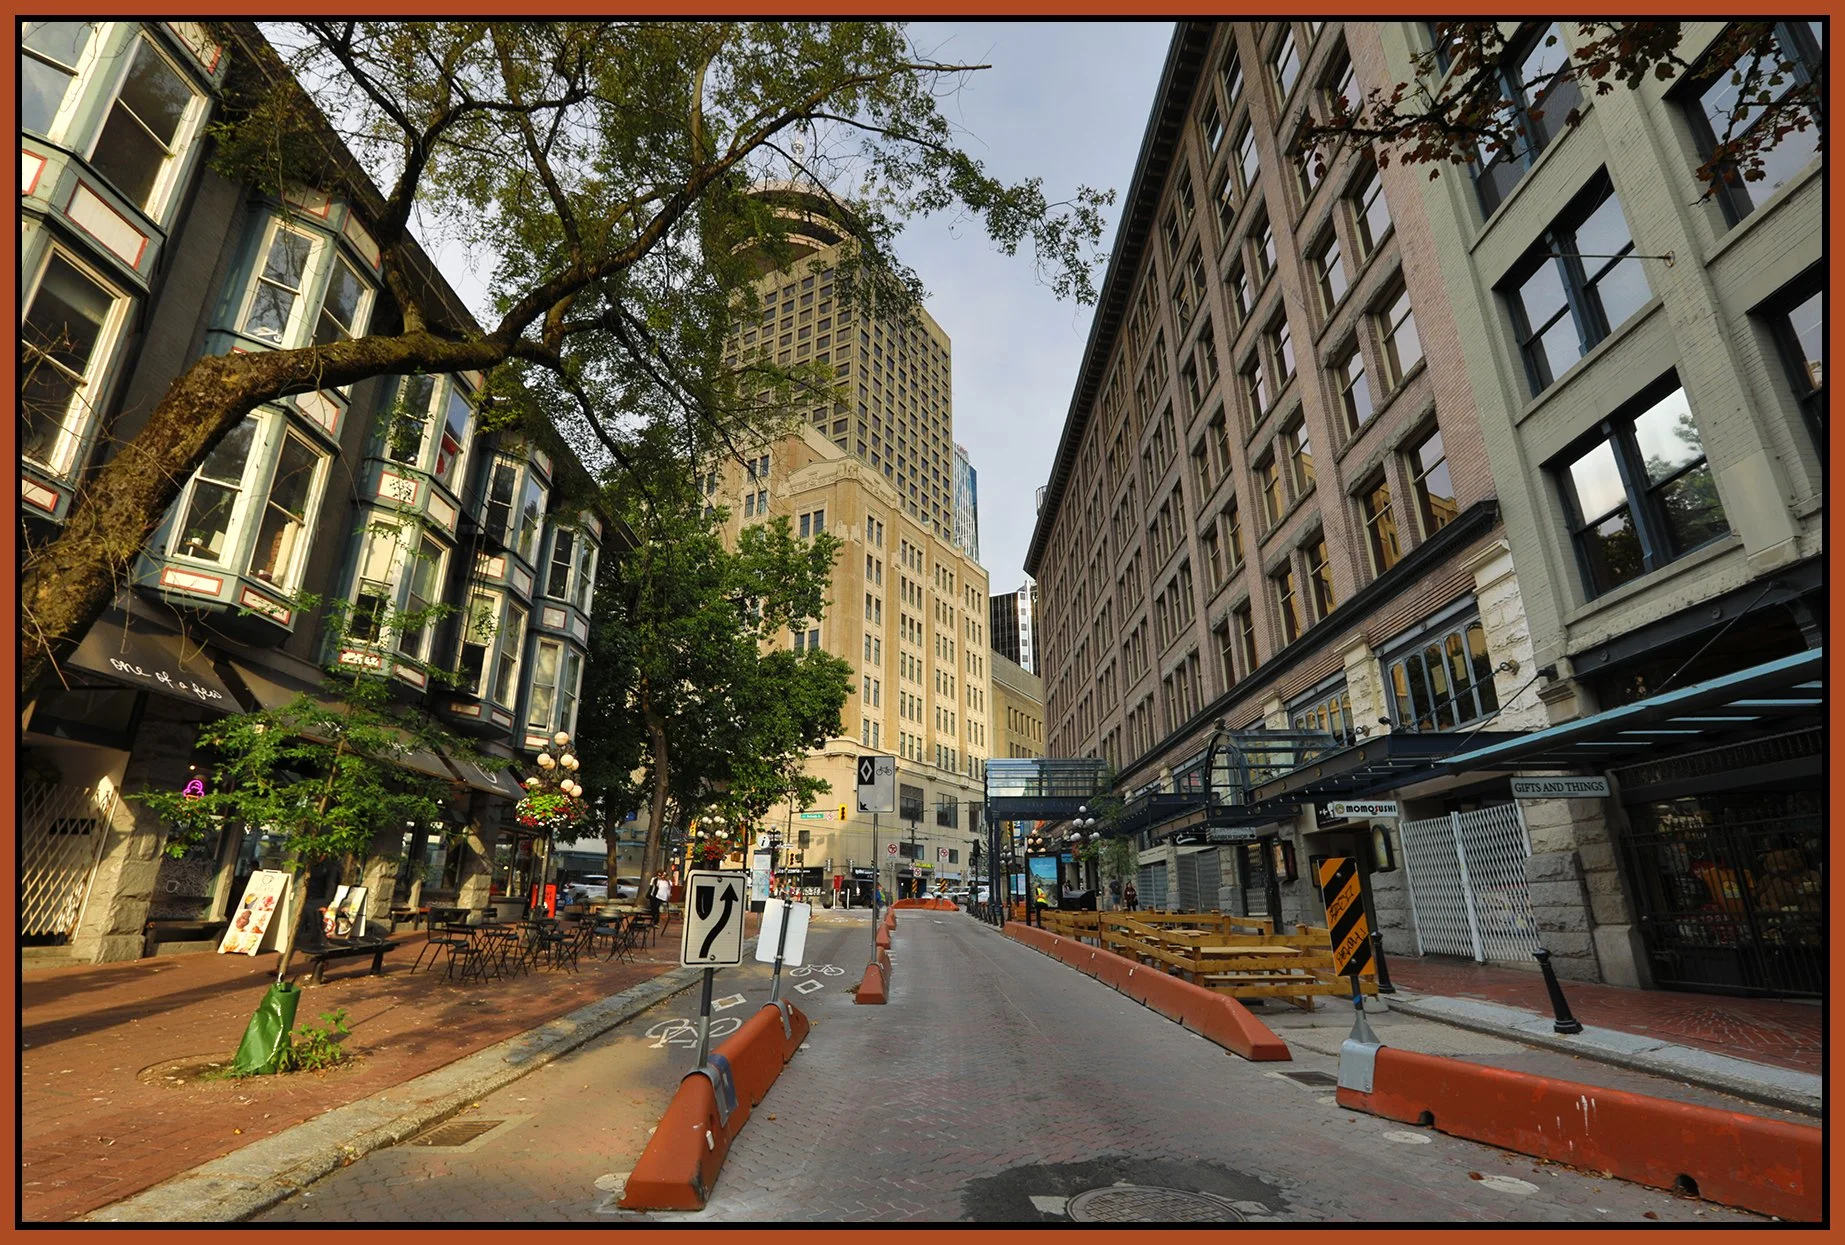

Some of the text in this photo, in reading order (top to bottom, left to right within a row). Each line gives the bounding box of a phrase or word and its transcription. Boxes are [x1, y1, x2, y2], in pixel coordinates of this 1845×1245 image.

[110, 658, 151, 677] one
[155, 671, 174, 688] of
[191, 682, 222, 700] few
[1514, 781, 1605, 793] GIFTS AND THINGS
